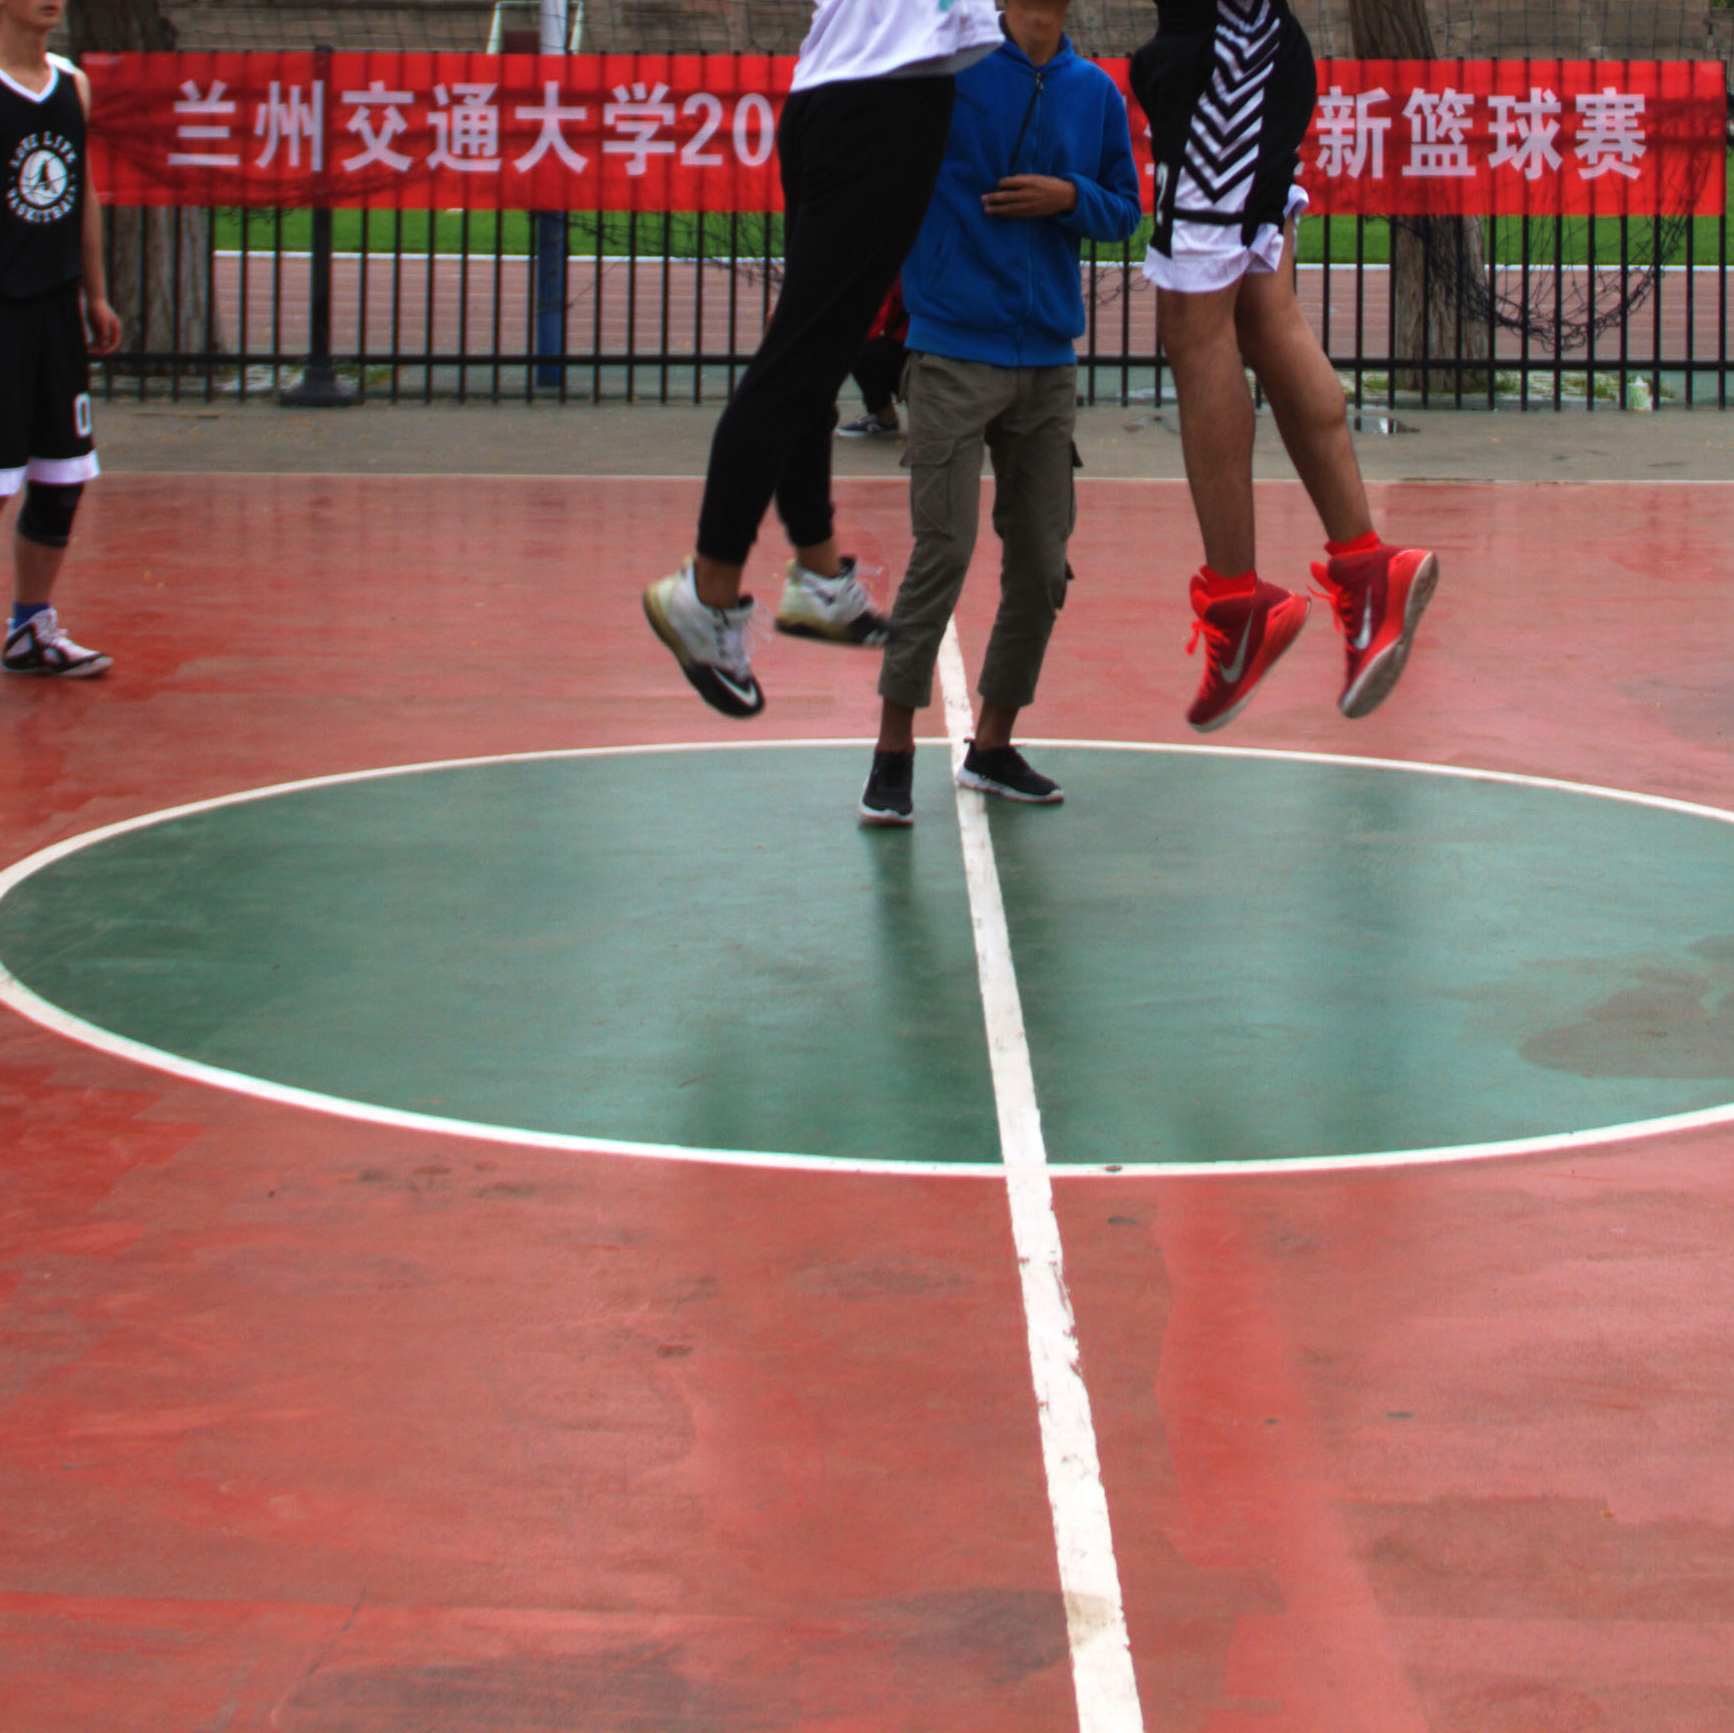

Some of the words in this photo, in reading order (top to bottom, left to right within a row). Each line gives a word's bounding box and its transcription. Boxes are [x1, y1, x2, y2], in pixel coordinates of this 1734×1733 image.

[167, 78, 777, 176] 兰州交通大学20
[1293, 86, 1647, 181] 新篮球赛
